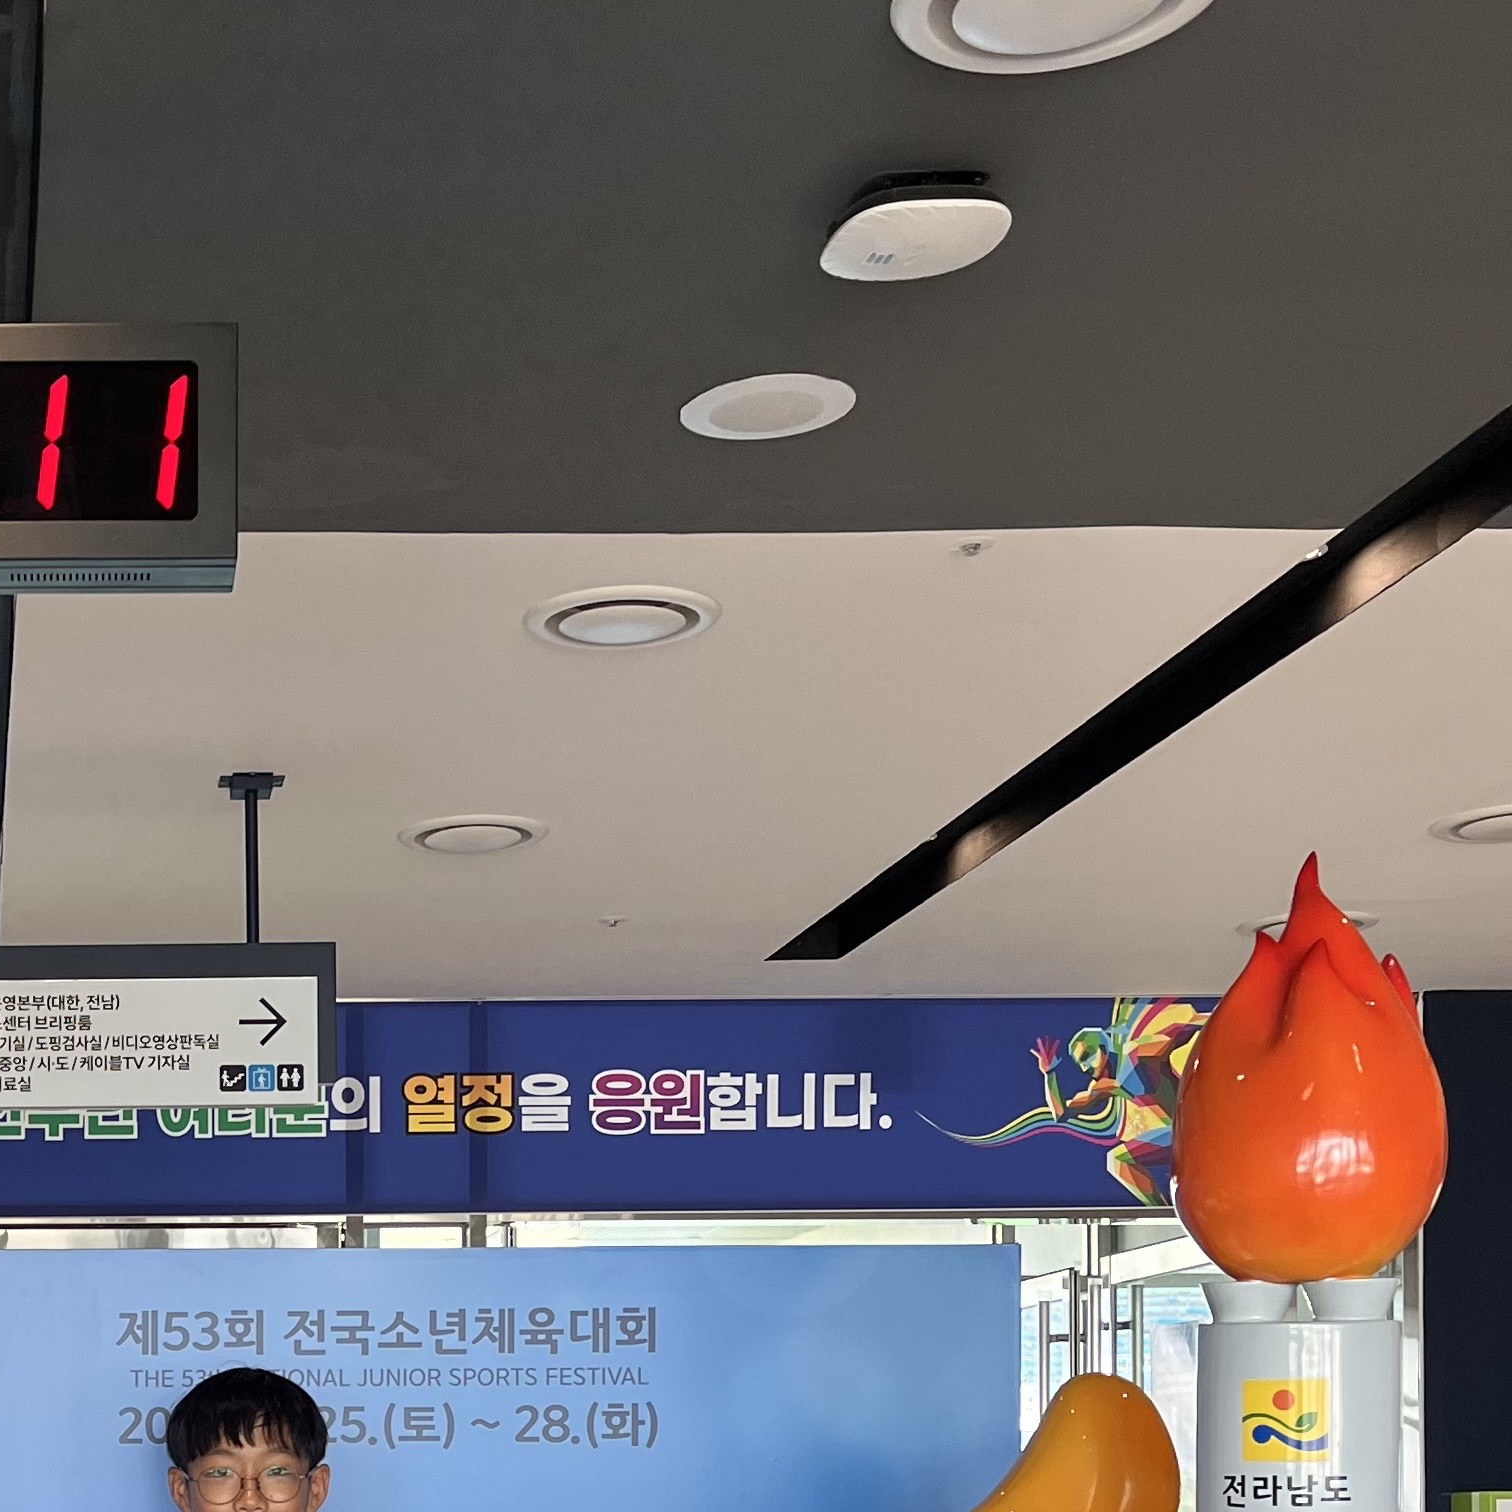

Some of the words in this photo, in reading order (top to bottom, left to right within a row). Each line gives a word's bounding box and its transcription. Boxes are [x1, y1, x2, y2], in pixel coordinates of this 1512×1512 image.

[86, 994, 120, 1012] 전남)
[34, 1014, 92, 1032] 브리핑룸
[34, 1035, 102, 1052] 도핑검사실
[111, 1033, 220, 1051] 비디오영상판독실
[147, 1053, 190, 1071] 기자실
[402, 1072, 573, 1135] 열정을
[588, 1067, 894, 1136] 응원합니다.
[115, 1309, 265, 1357] 제53회
[283, 1306, 657, 1356] 전국소년체육대회
[129, 1369, 175, 1388] THE
[356, 1367, 442, 1387] JUNIOR
[448, 1366, 538, 1387] SPORTS
[545, 1366, 650, 1386] FESTIVAL
[514, 1401, 659, 1450] 28.(화)
[1222, 1474, 1352, 1509] 전라남도
